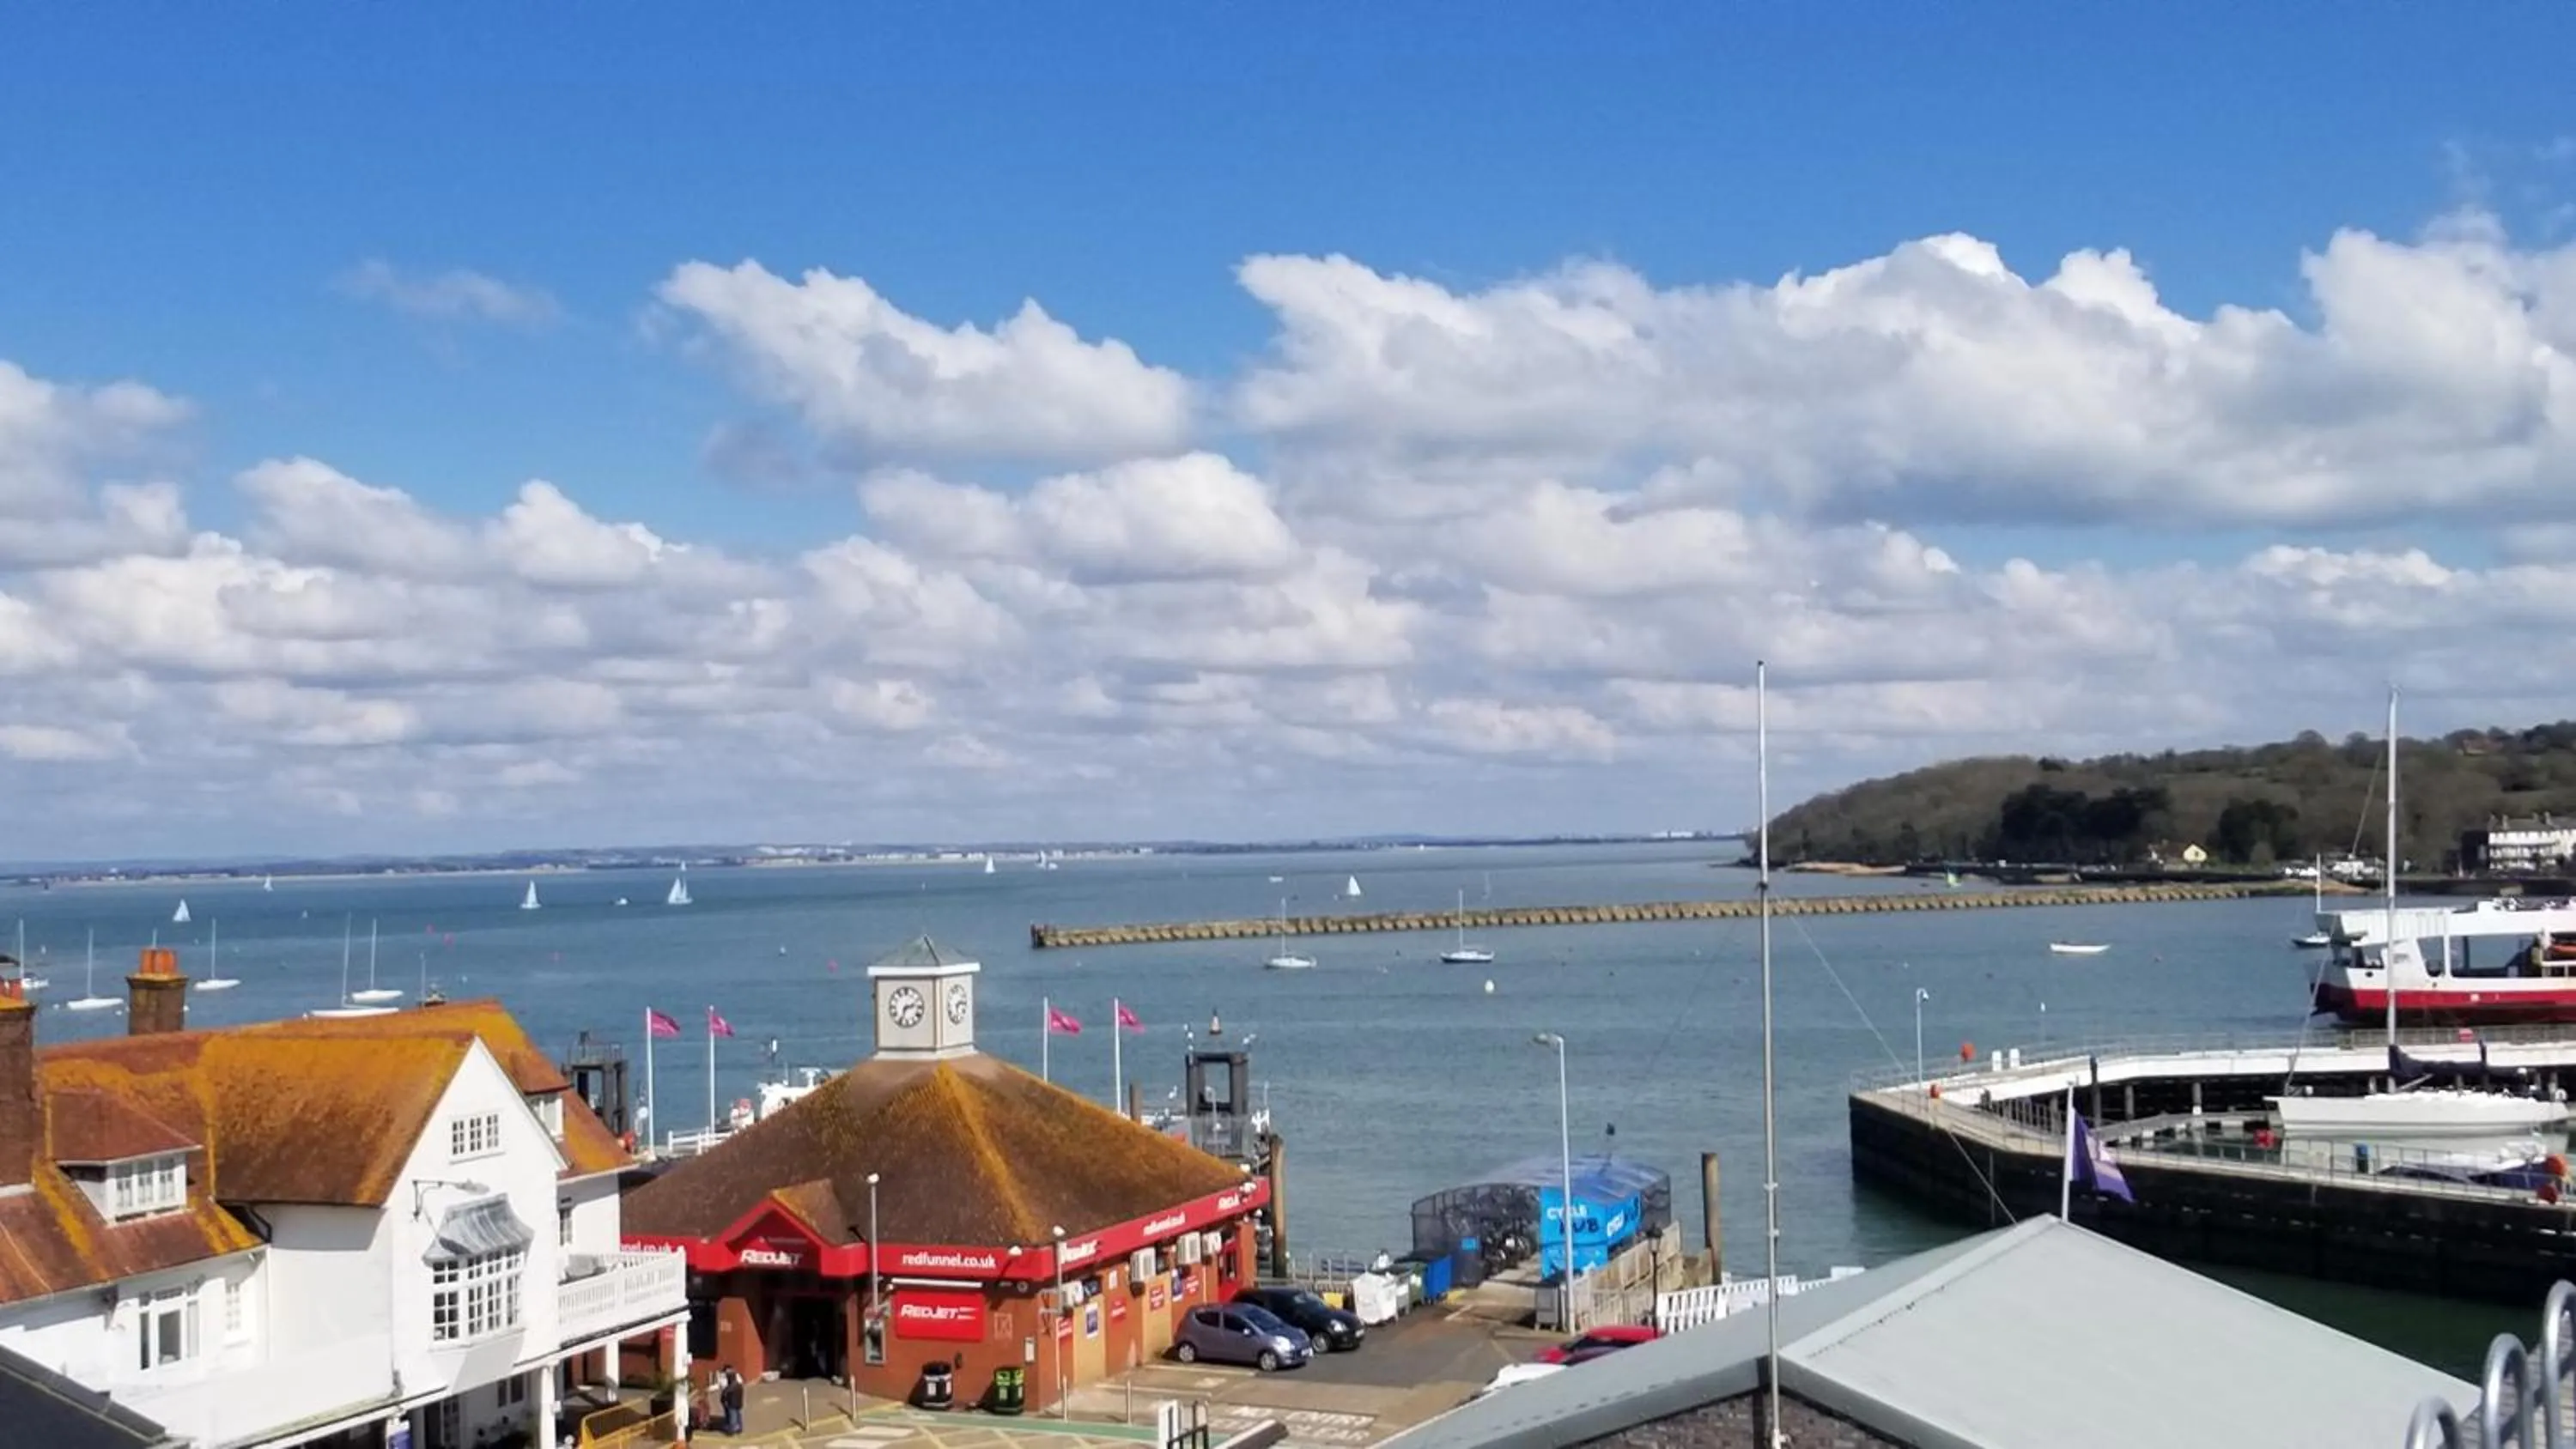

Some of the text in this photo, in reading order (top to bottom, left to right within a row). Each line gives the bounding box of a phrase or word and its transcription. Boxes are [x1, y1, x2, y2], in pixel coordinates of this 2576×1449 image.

[1546, 1203, 1588, 1221] CYLE
[902, 1252, 996, 1269] redfunnel.co.uk
[901, 1304, 960, 1319] REDJET
